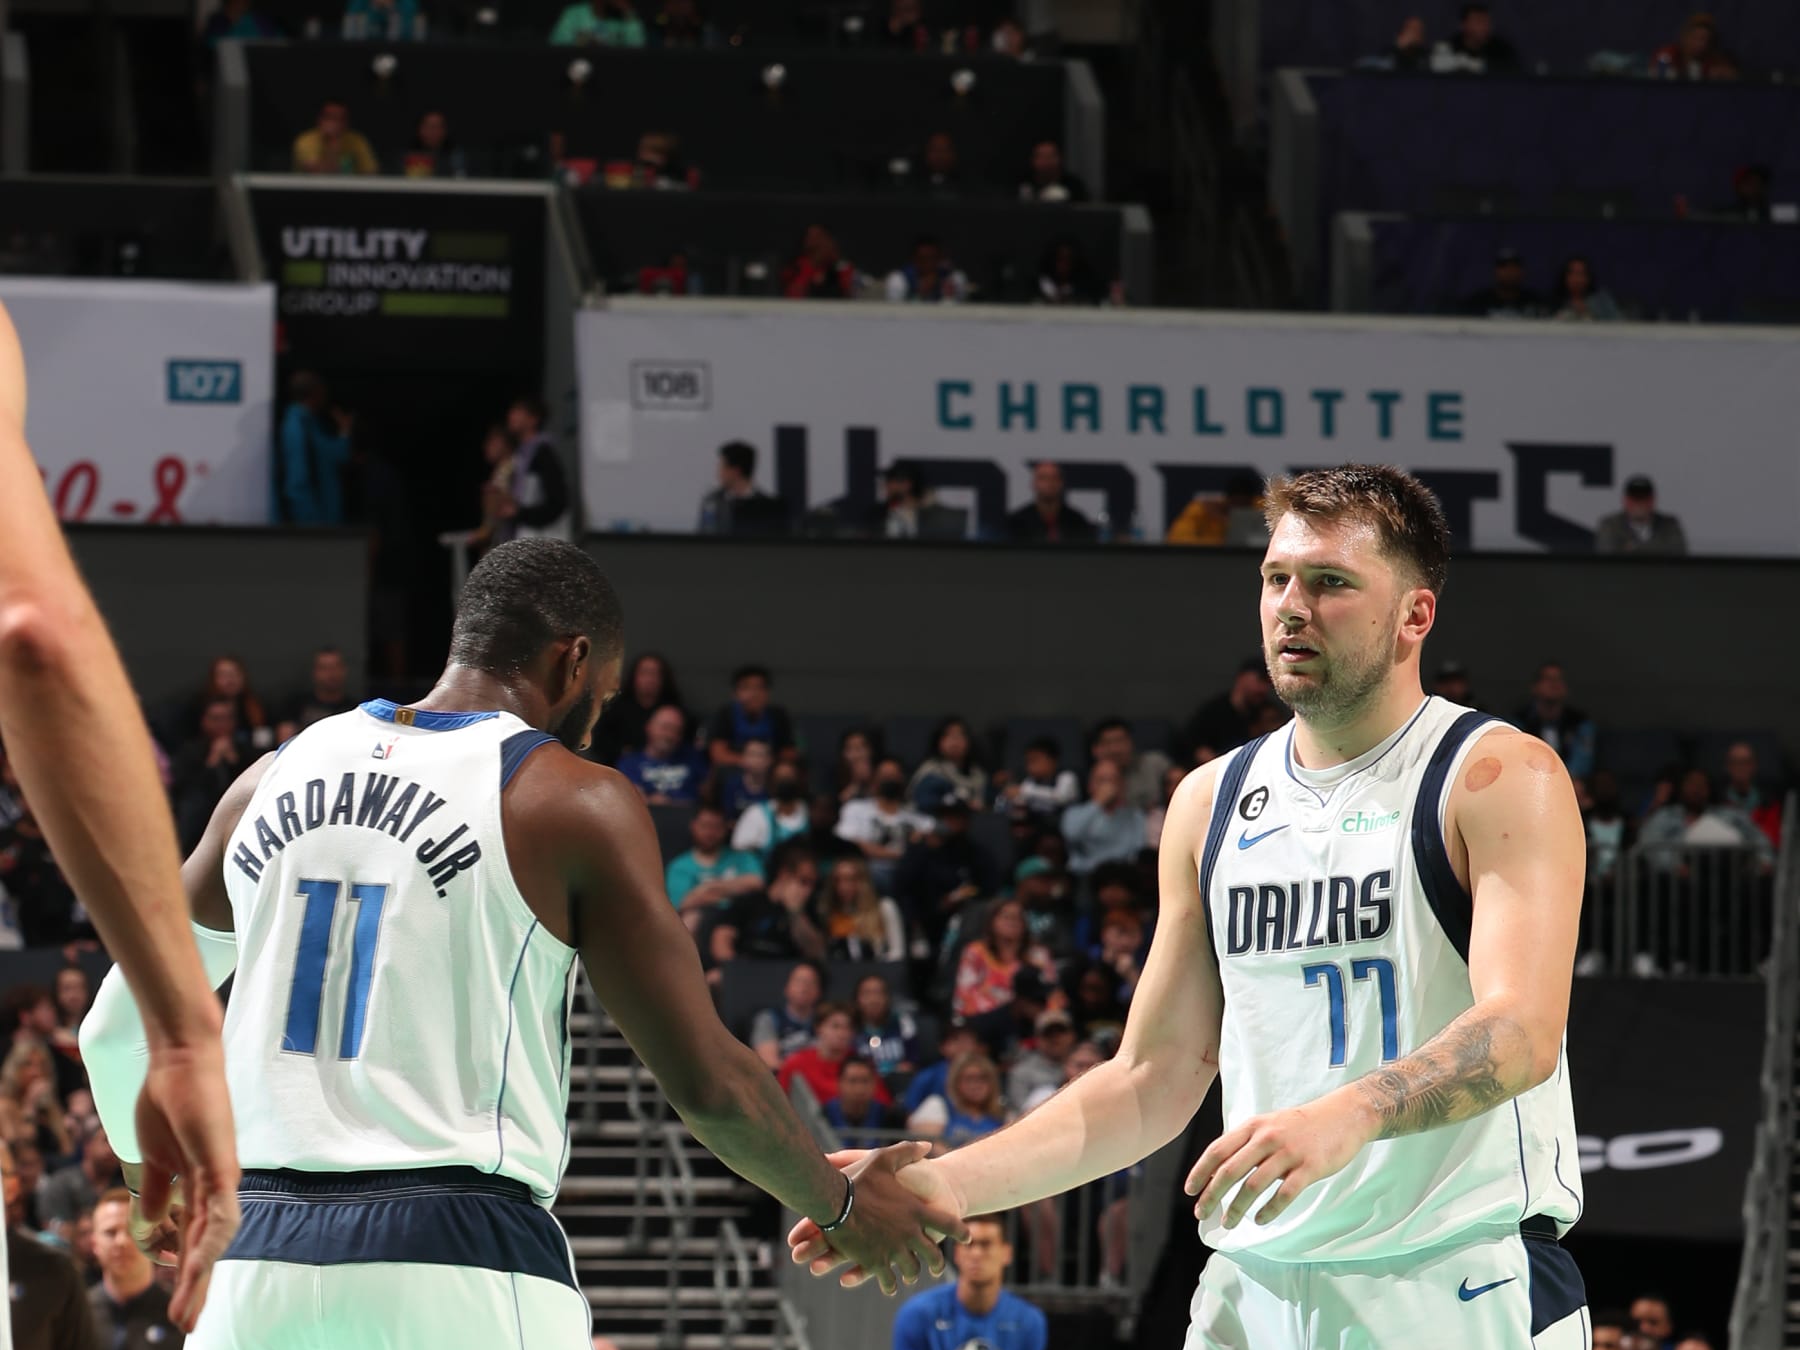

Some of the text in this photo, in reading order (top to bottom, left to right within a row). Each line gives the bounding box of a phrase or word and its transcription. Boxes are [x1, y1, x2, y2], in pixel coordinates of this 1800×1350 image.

[282, 227, 427, 259] UTILITY
[327, 263, 511, 291] INNOVATION
[281, 291, 378, 314] GROUP
[175, 366, 235, 398] 107
[643, 370, 700, 400] 108
[936, 379, 1465, 441] CHARLOTTE
[233, 772, 482, 899] HARDAWAY JR.
[1226, 868, 1394, 958] DALLAS
[280, 877, 391, 1061] 11
[1301, 957, 1401, 1069] 77
